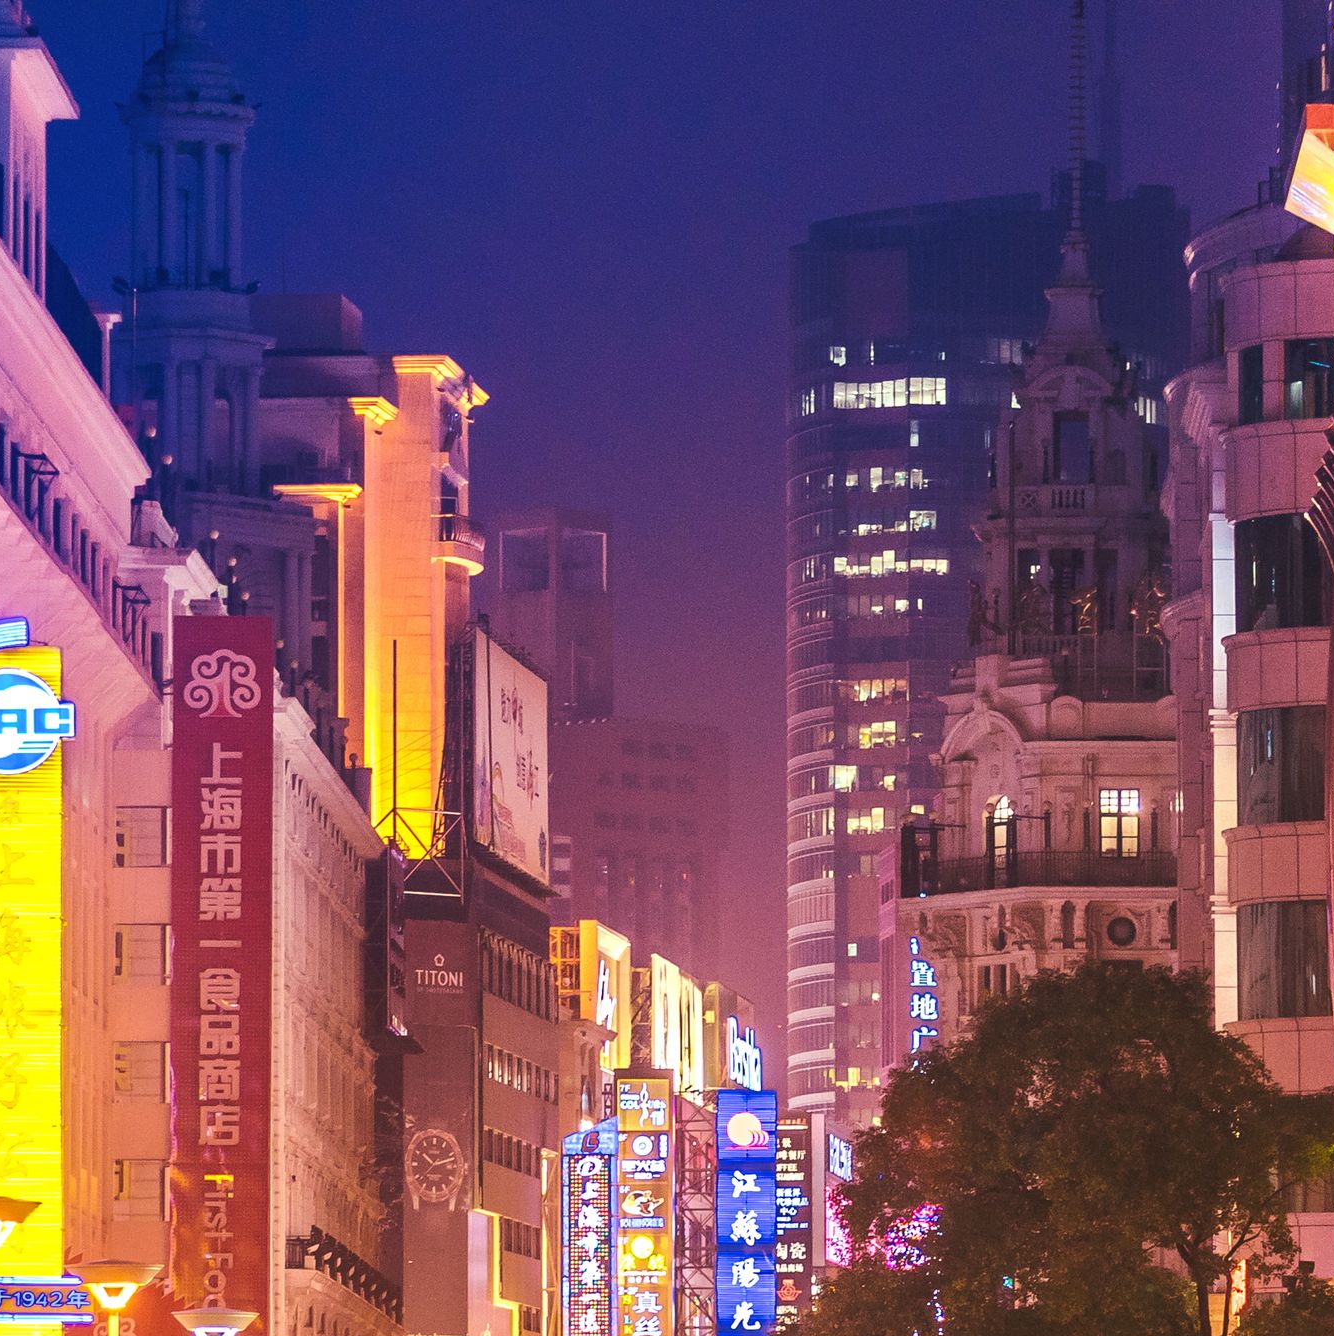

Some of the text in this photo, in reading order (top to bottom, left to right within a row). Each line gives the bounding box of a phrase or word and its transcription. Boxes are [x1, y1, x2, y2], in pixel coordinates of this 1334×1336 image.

[198, 742, 243, 1147] 上海市第一食品商店
[415, 969, 463, 987] TITONI
